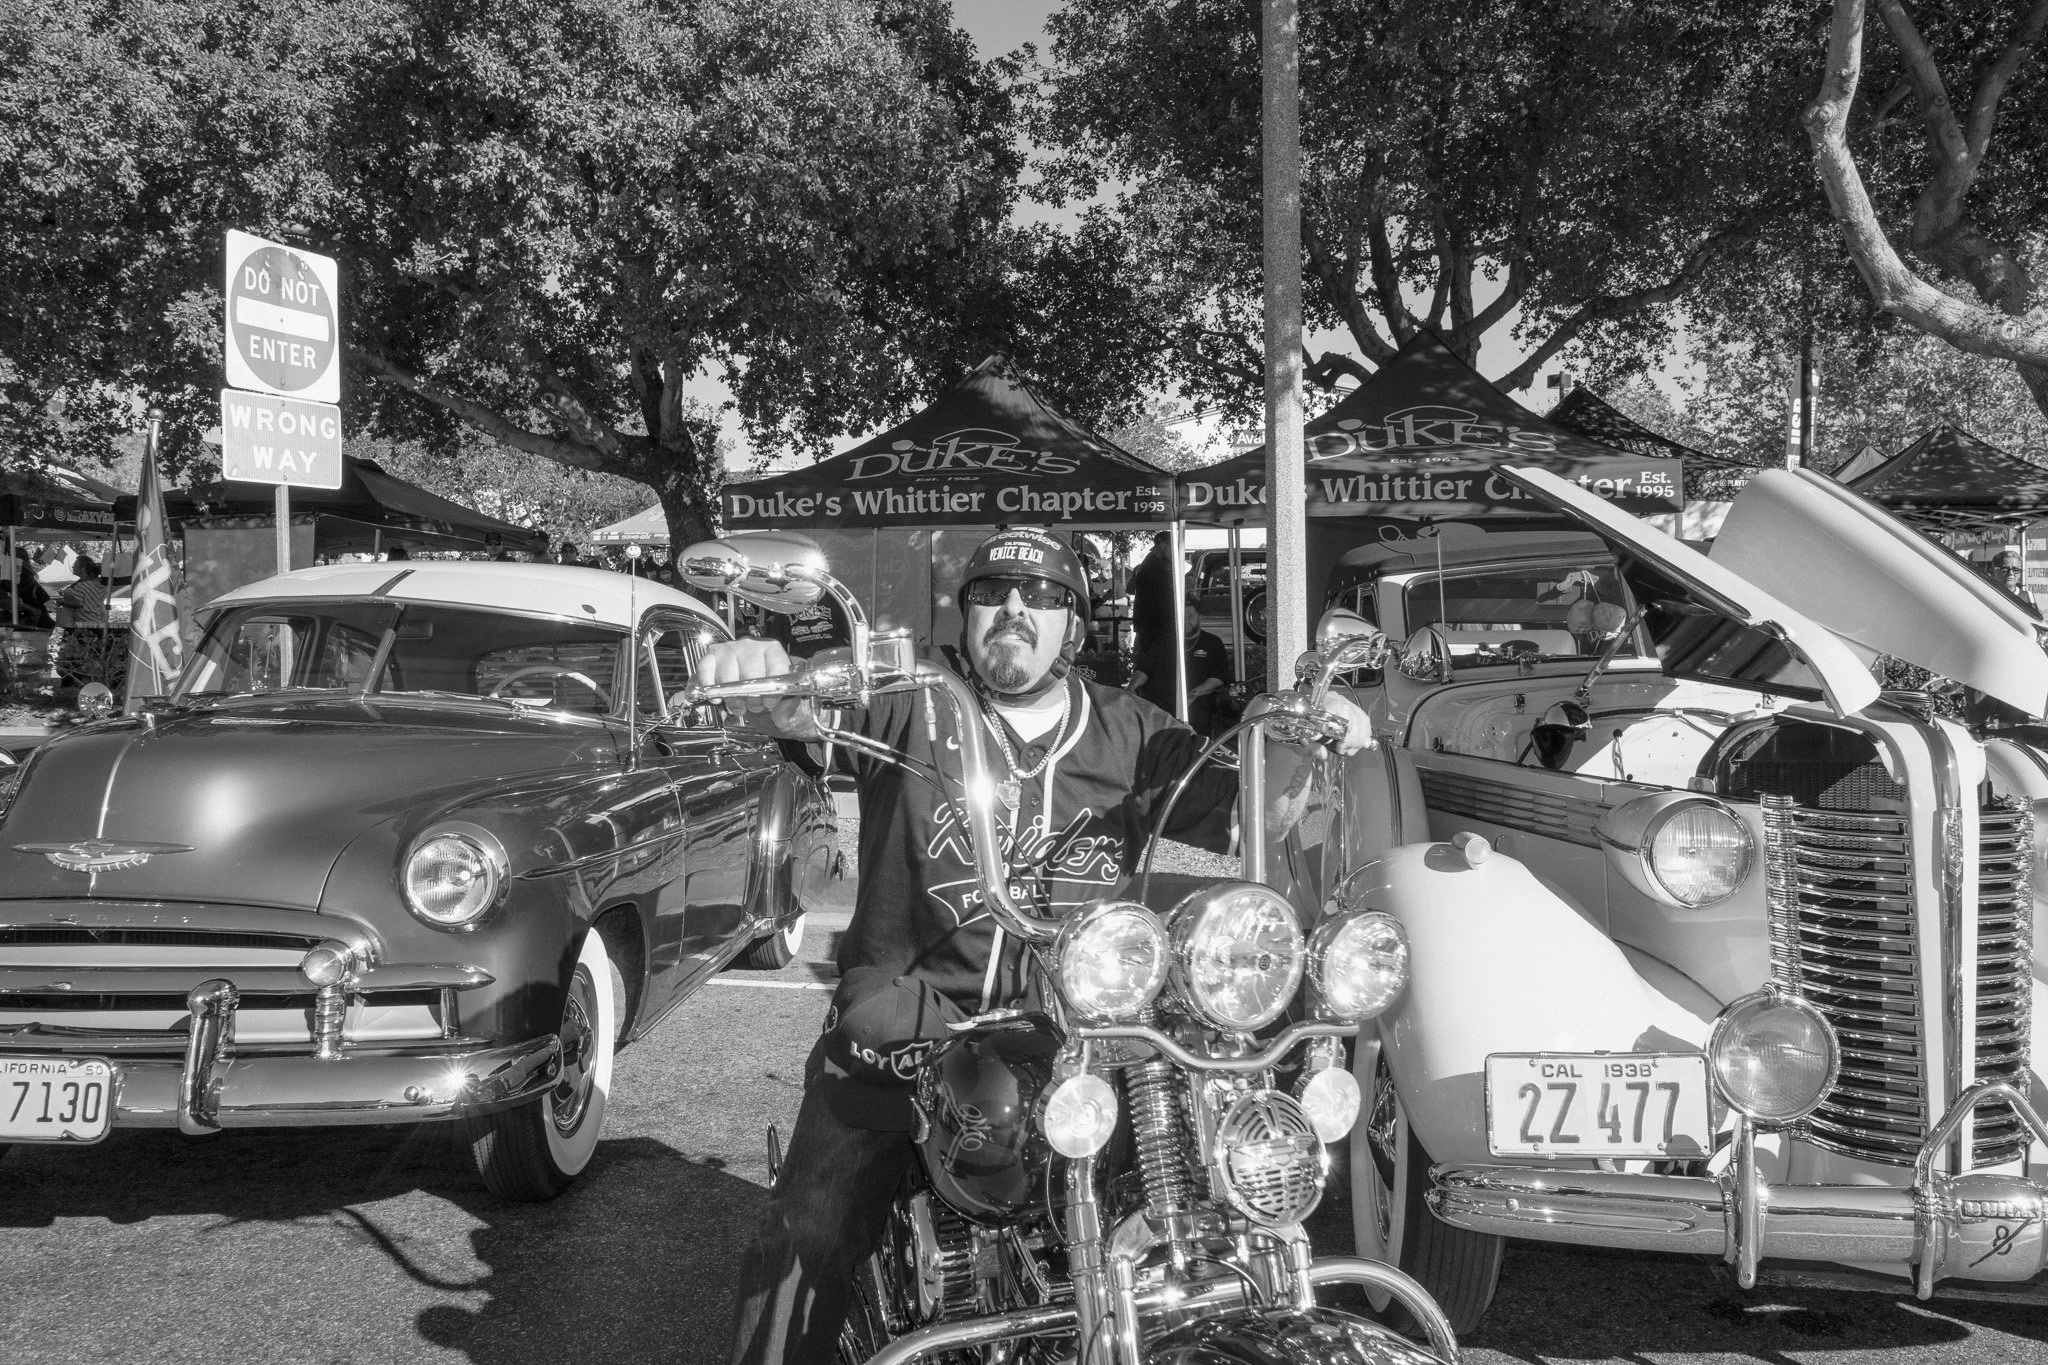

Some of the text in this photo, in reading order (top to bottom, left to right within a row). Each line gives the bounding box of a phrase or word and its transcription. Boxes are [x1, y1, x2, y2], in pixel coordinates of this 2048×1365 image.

[244, 266, 320, 307] DO NOT
[250, 334, 317, 370] ENTER
[229, 403, 336, 440] WRONG
[252, 445, 318, 474] WAY
[1320, 472, 1473, 503] Whittier
[1640, 471, 1672, 484] Est.
[730, 485, 1132, 520] Duke's Whittier Chapter
[1135, 486, 1161, 496] Est.
[1635, 485, 1675, 498] 1995
[1133, 501, 1165, 513] 1995
[989, 546, 1044, 565] VENICE BEACH
[85, 1064, 104, 1076] 50
[1541, 1063, 1652, 1078] CAL 1938
[9, 1080, 103, 1123] 7130
